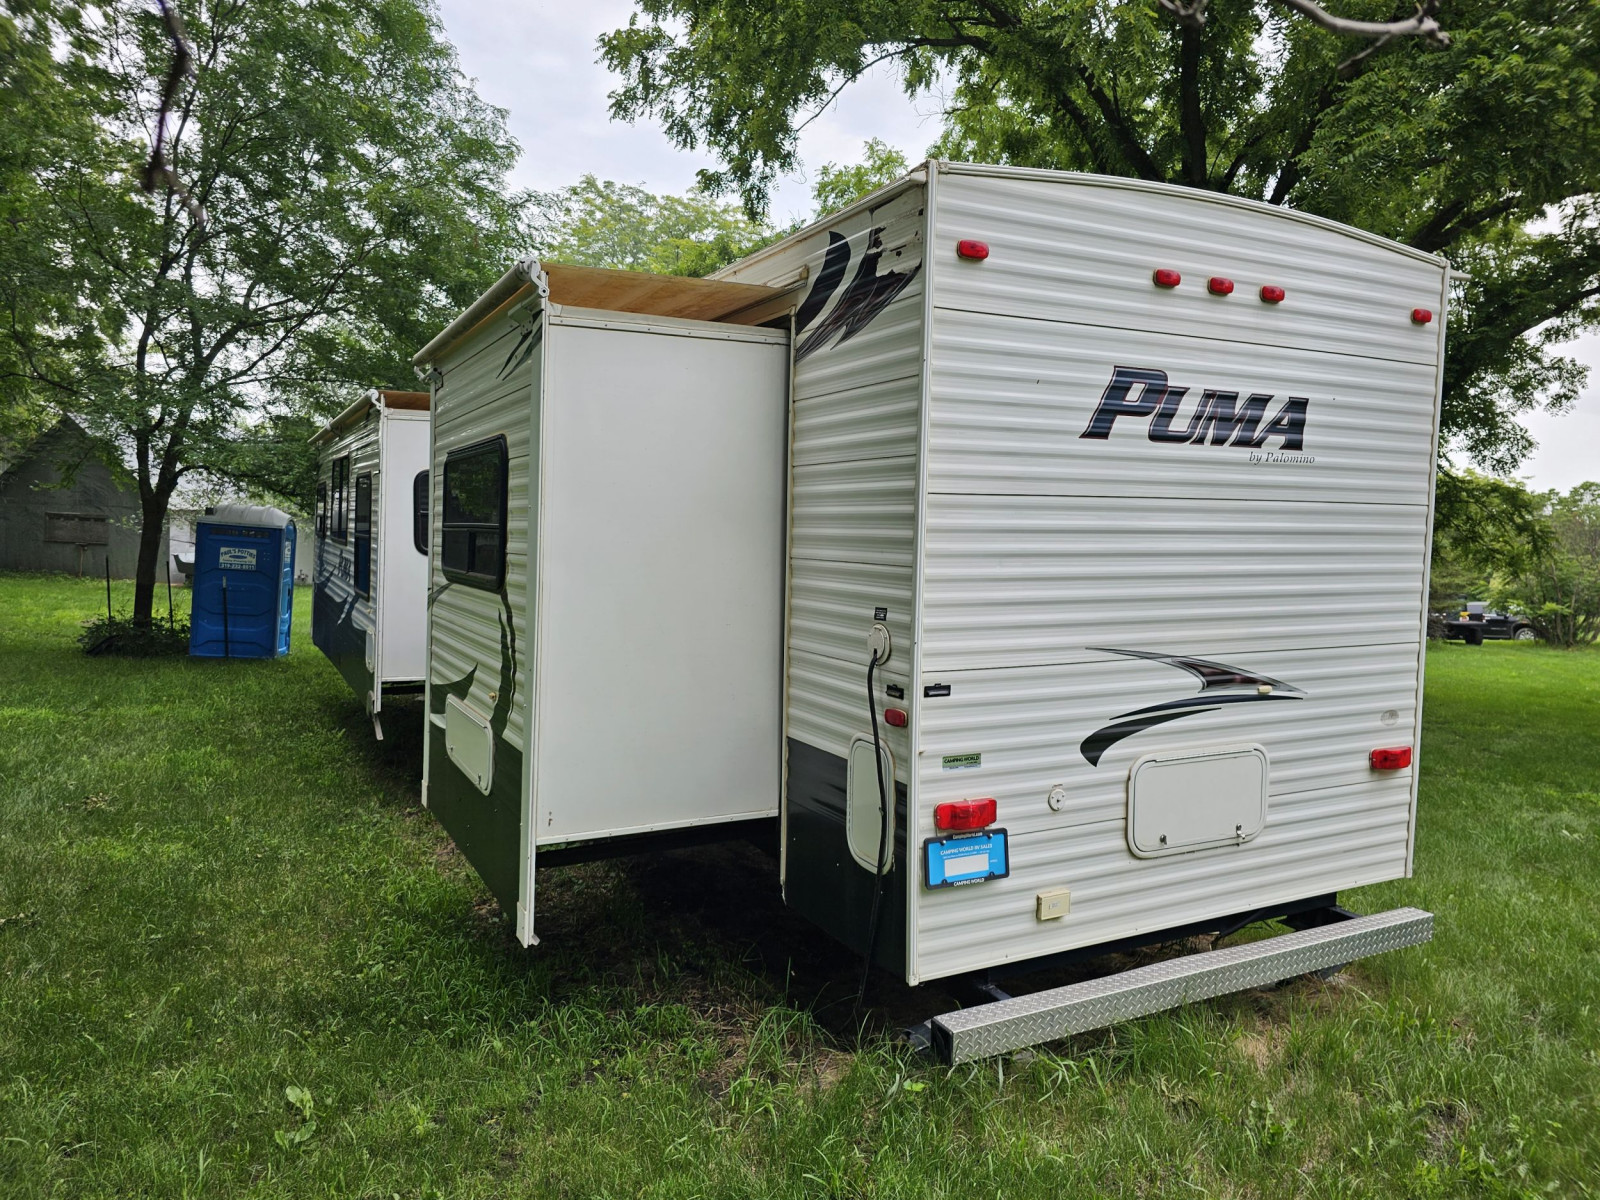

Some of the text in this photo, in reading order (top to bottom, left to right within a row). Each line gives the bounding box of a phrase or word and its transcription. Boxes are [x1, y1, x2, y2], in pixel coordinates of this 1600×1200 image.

[1079, 365, 1310, 451] PUMA
[1249, 452, 1315, 465] by Palomino
[221, 549, 256, 559] PAUL'S POTTIES
[953, 879, 971, 887] CAMPING
